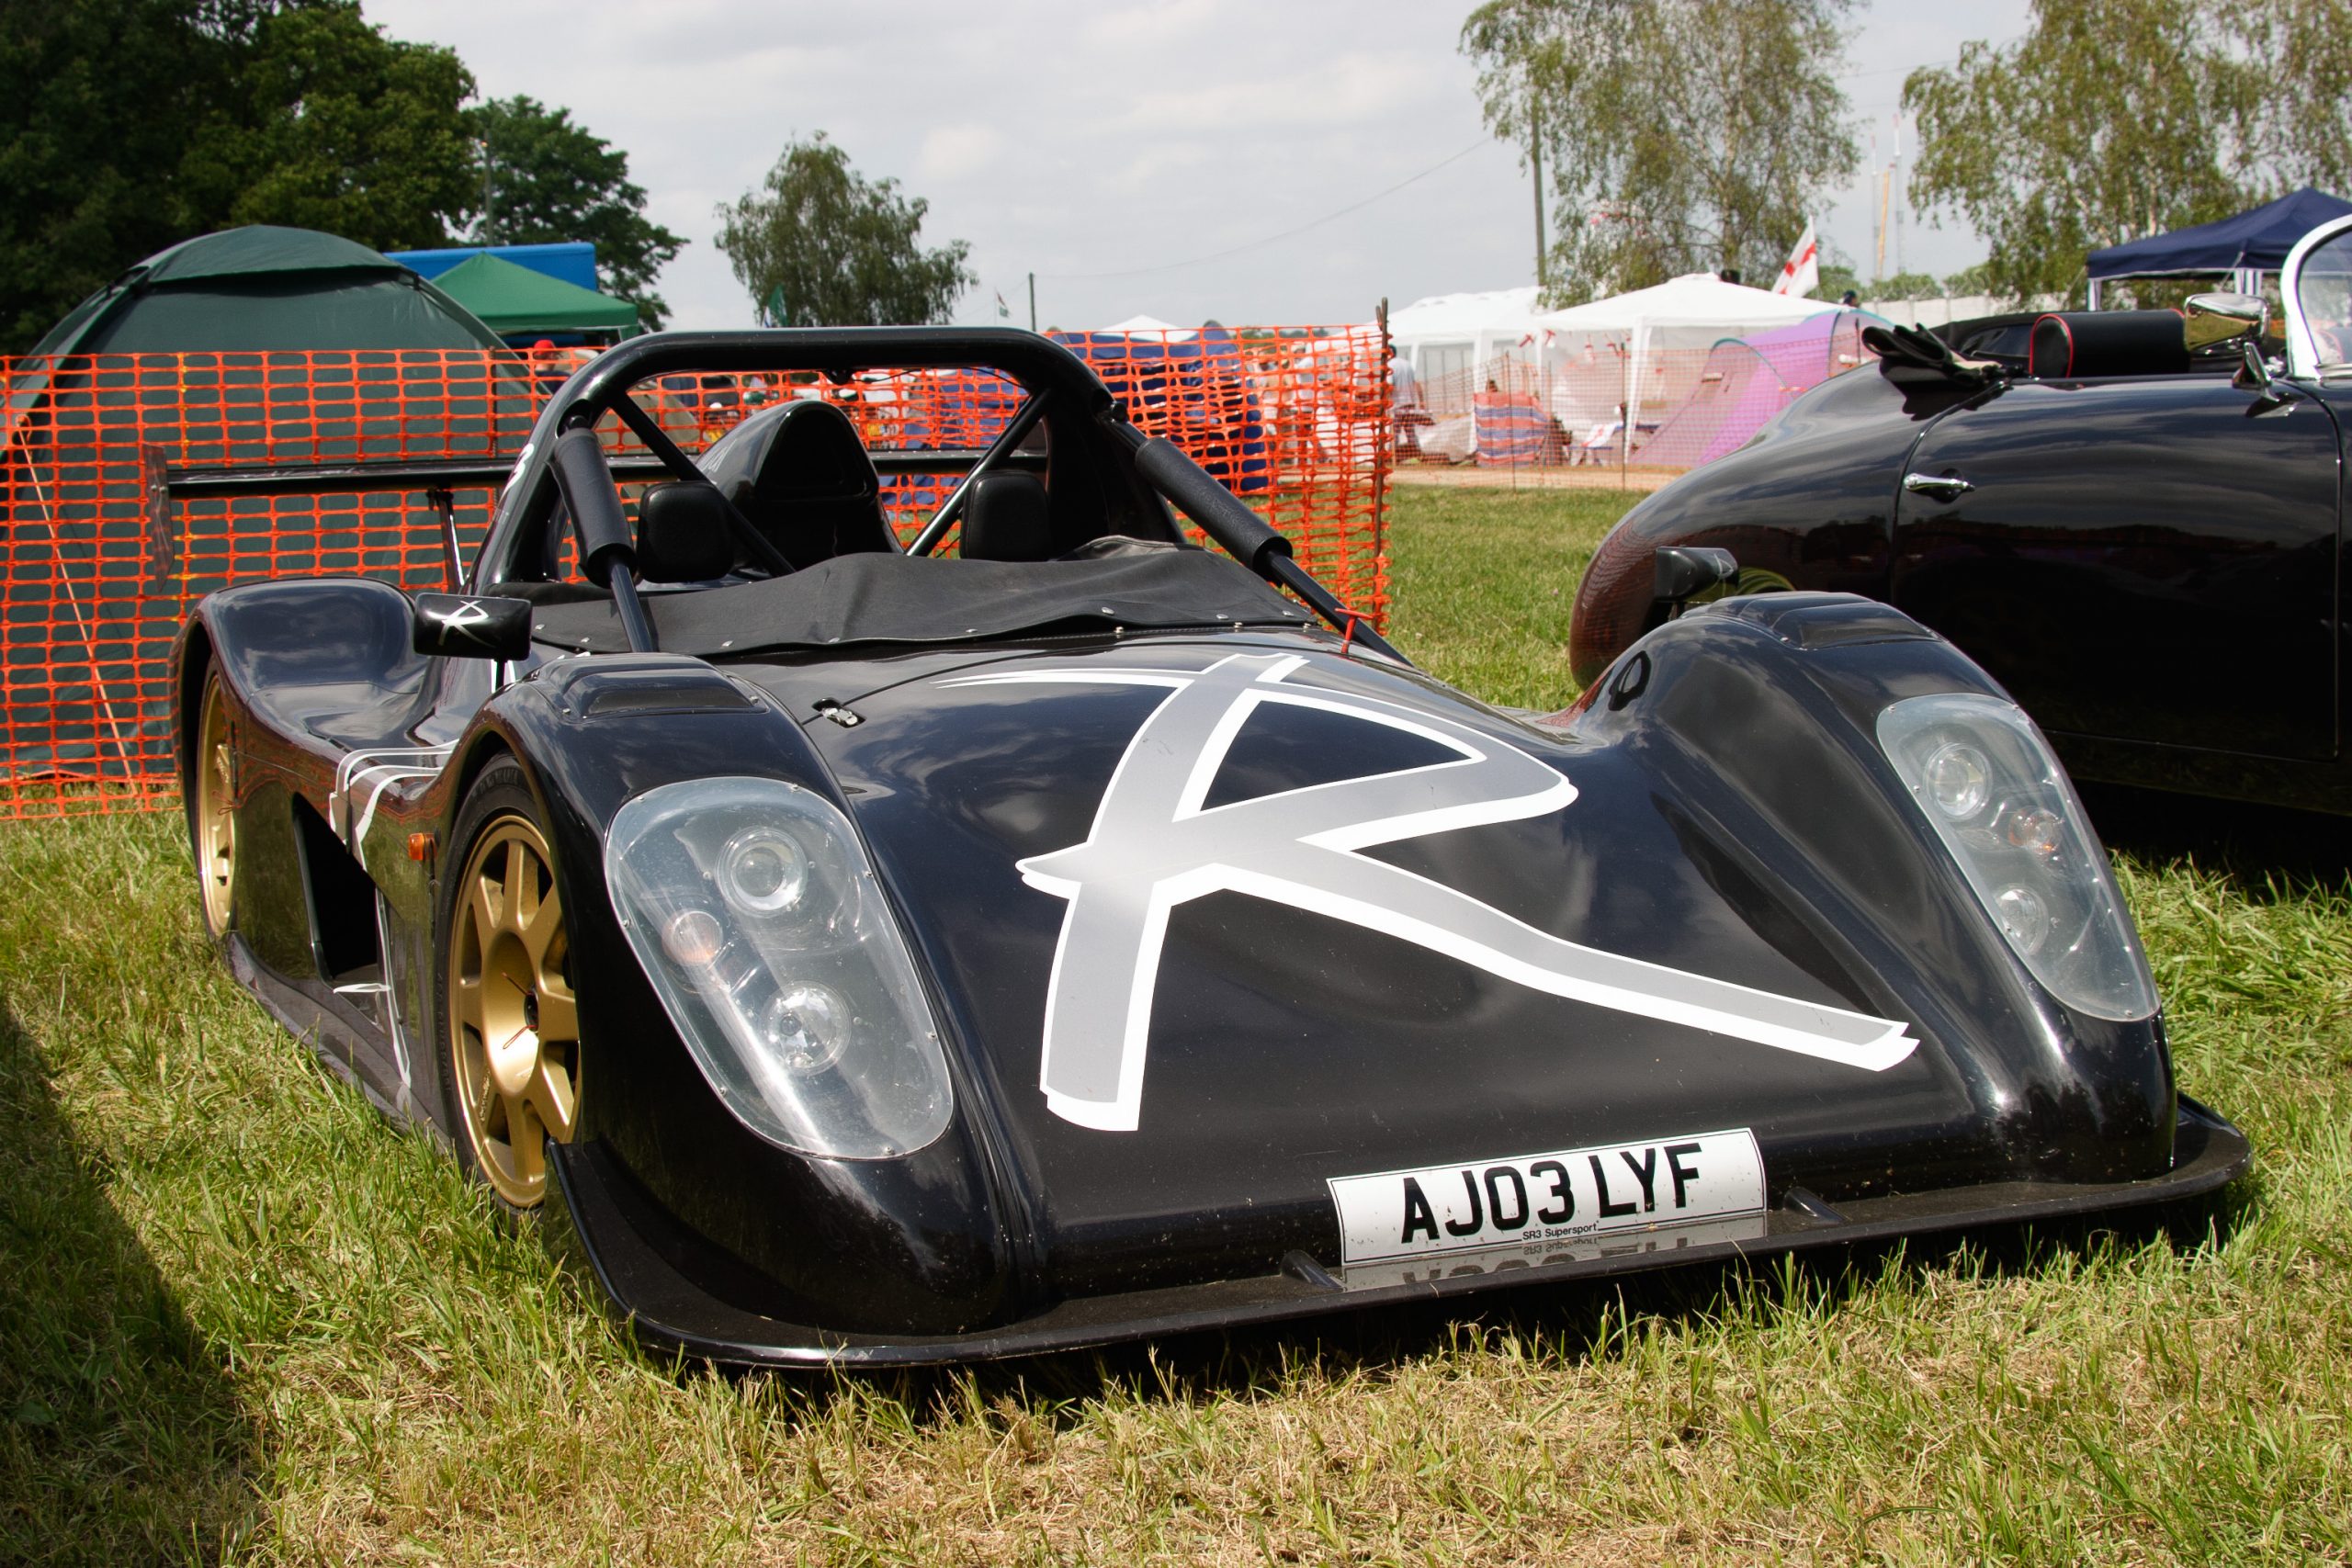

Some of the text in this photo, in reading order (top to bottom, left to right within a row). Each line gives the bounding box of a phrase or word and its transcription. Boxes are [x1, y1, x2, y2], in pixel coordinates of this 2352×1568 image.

[929, 653, 1920, 1131] R
[1401, 1142, 1702, 1244] AJ03 LYF
[1522, 1223, 1597, 1240] SR3 Supersport
